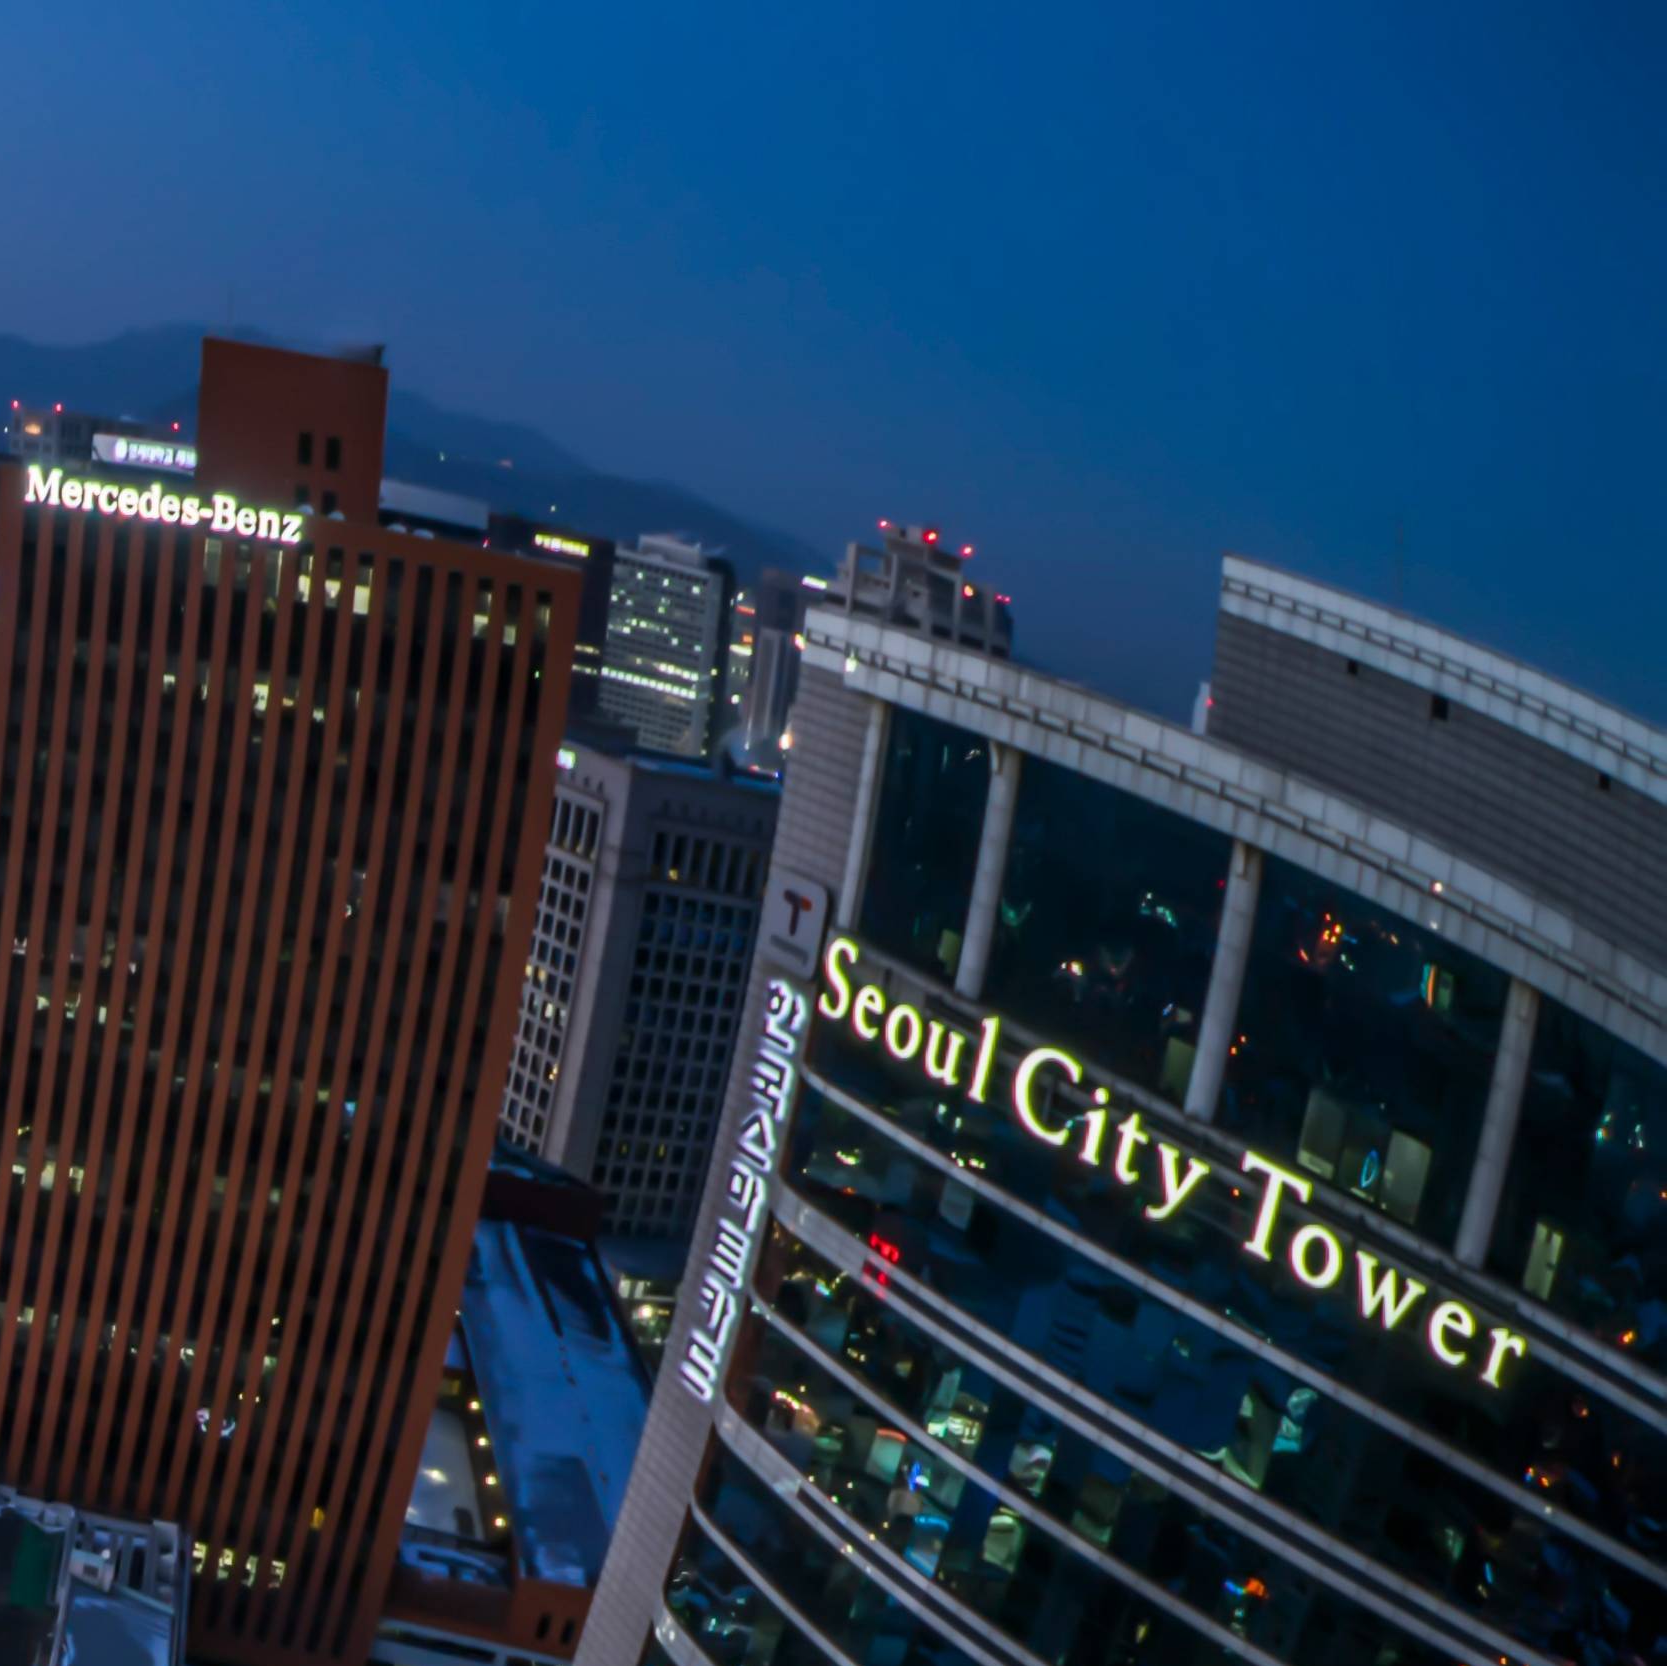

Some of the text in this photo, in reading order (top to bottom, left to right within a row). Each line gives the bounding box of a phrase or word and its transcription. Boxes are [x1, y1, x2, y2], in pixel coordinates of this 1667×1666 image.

[24, 464, 304, 544] Mercedes-Benz
[679, 979, 807, 1402] 한국스마트카드
[819, 937, 1527, 1389] Seoul City Tower
